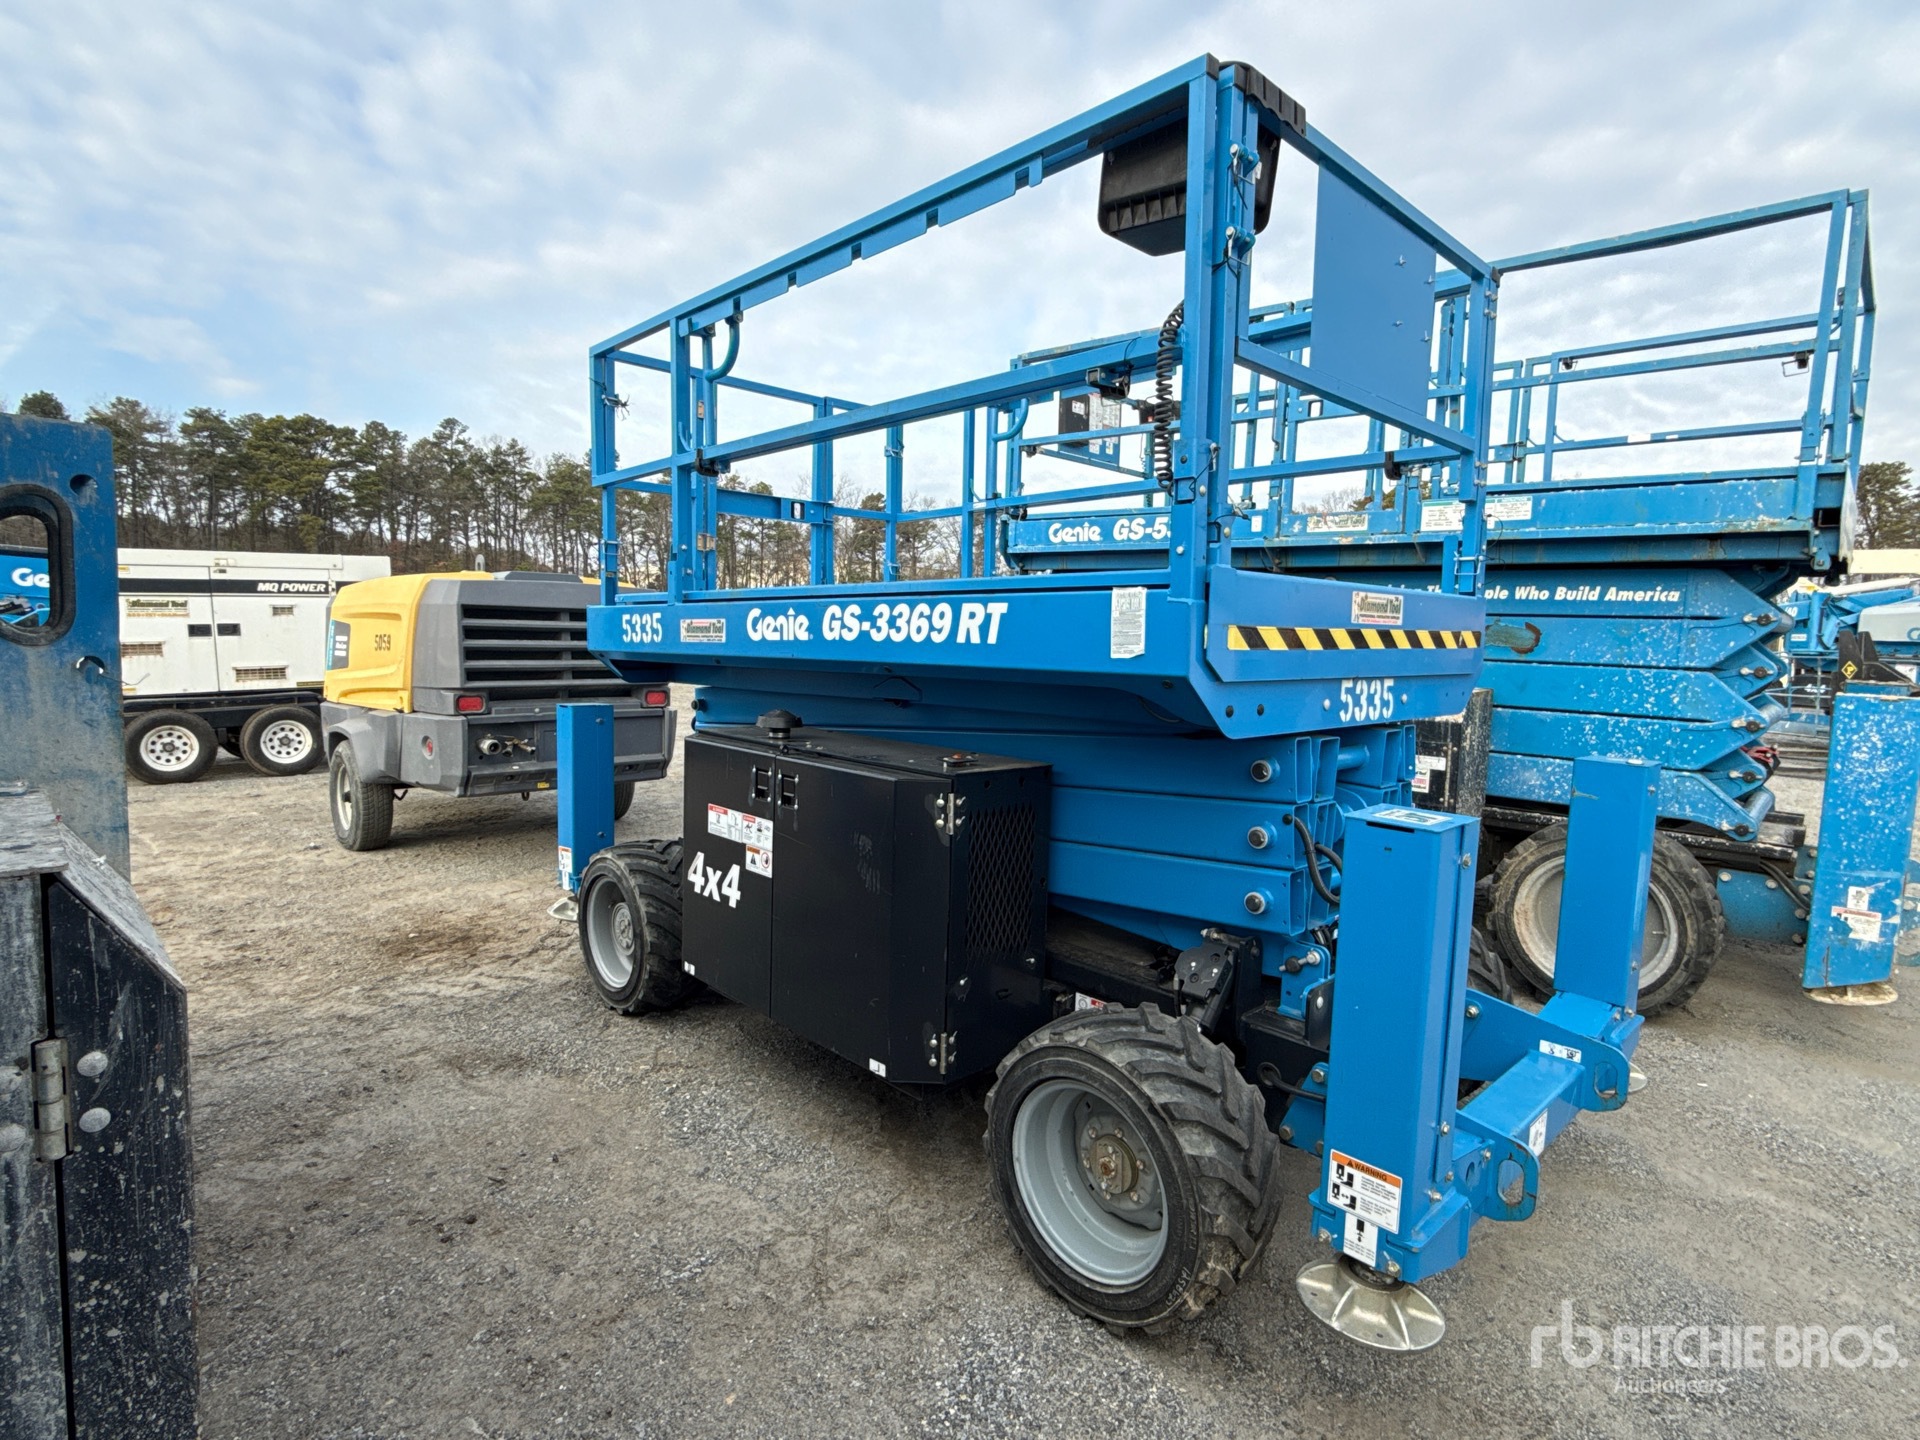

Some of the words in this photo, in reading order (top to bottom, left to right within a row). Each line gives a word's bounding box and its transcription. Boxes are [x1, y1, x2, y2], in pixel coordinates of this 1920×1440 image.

[1049, 522, 1101, 543] Genie
[1113, 517, 1171, 541] GS-5
[257, 582, 278, 592] MQ
[280, 582, 326, 592] POWER
[1515, 586, 1549, 601] Who
[1554, 586, 1600, 601] Build
[1604, 586, 1680, 602] America
[1360, 596, 1388, 613] Diamond
[1389, 598, 1401, 615] Tool
[622, 612, 662, 643] 5335
[687, 621, 711, 634] Diamond
[712, 621, 724, 634] Tool
[747, 607, 809, 641] Genie
[822, 602, 953, 643] GS-3369
[956, 602, 1008, 645] RT
[375, 634, 391, 651] 5059
[1339, 678, 1394, 722] 5335
[688, 851, 741, 909] 4x4
[1354, 1163, 1388, 1181] WARNING
